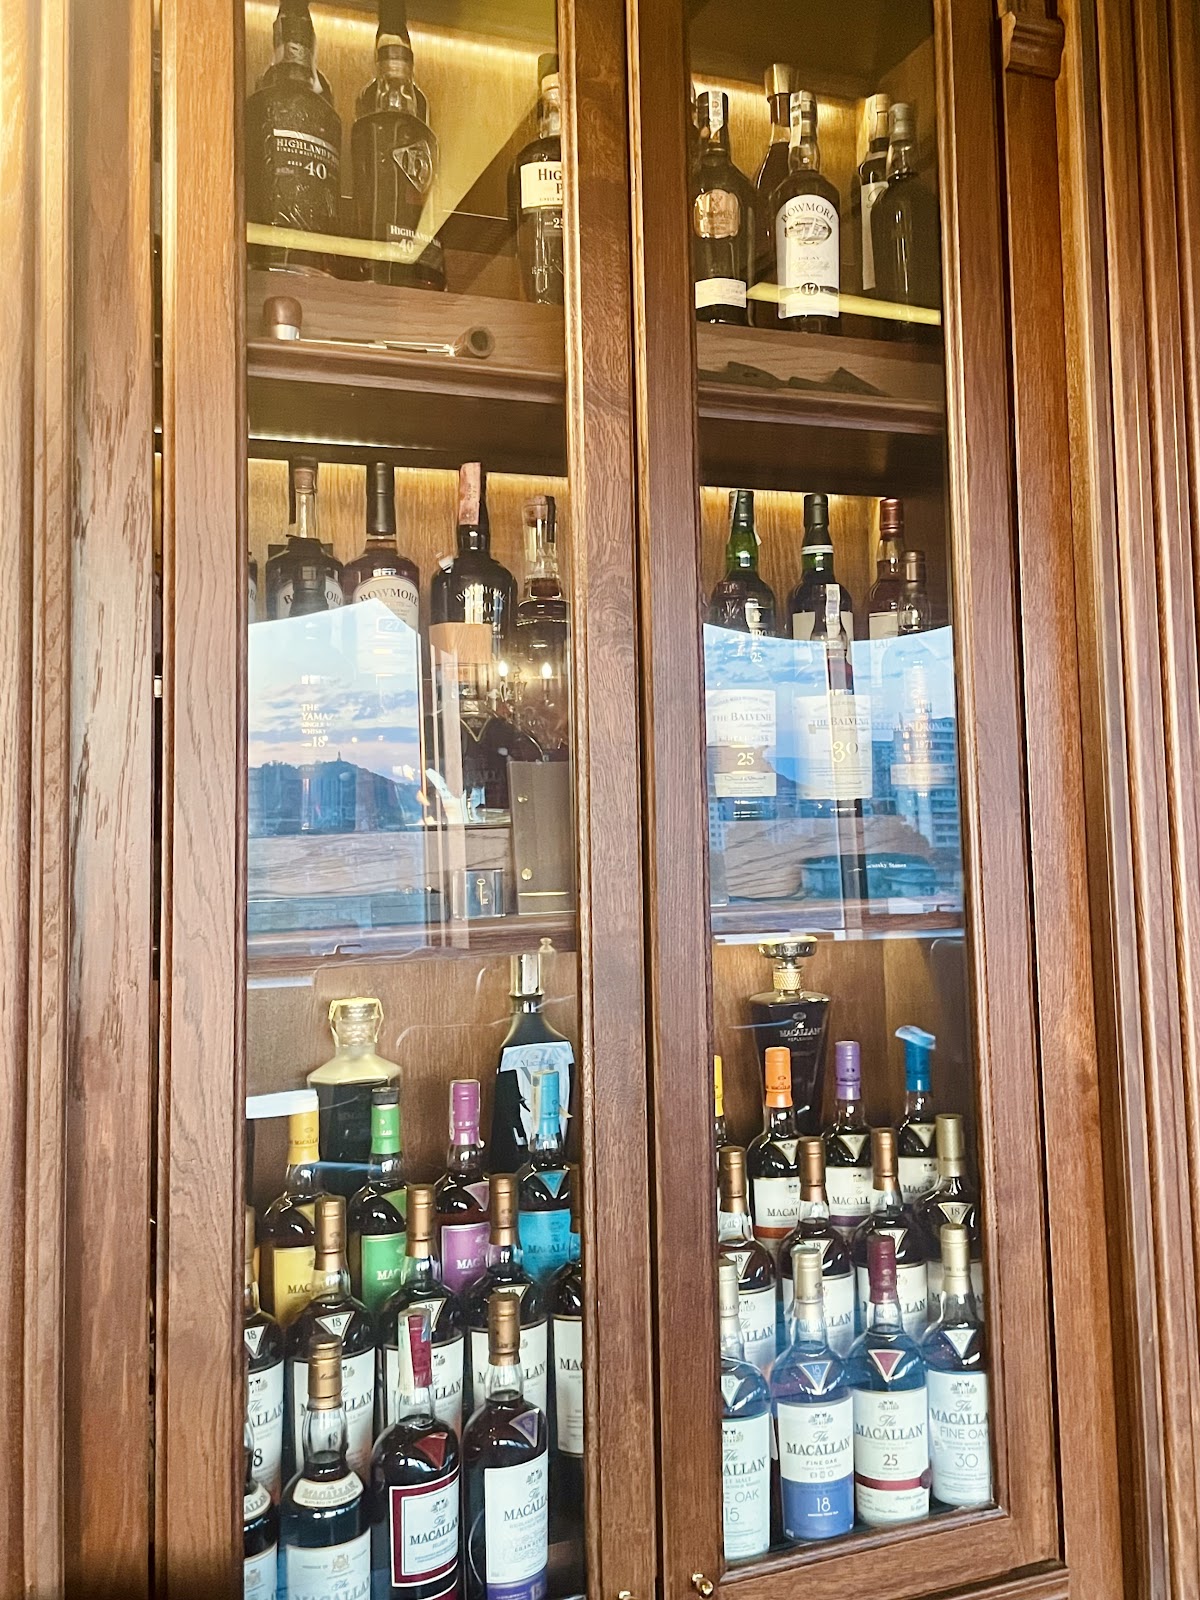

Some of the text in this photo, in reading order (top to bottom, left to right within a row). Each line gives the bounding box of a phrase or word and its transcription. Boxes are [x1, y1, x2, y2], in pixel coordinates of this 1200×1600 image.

[277, 139, 327, 157] HIGHLAND
[304, 161, 327, 180] 40
[804, 283, 816, 295] 17
[751, 651, 763, 663] 25
[731, 712, 772, 722] BALVENIE
[737, 752, 755, 766] 25
[779, 1027, 822, 1037] MACALLAN
[950, 1206, 961, 1215] 18
[331, 1317, 341, 1328] 18
[246, 1330, 257, 1340] 18
[878, 1414, 897, 1427] The
[812, 1430, 829, 1444] The
[855, 1422, 925, 1441] MACALLAN
[940, 1425, 965, 1440] FINE
[786, 1436, 851, 1457] MACALLAN
[883, 1453, 899, 1467] 25
[955, 1452, 979, 1468] 30
[734, 1488, 760, 1503] OAK
[816, 1497, 831, 1512] 18
[725, 1507, 740, 1522] 15
